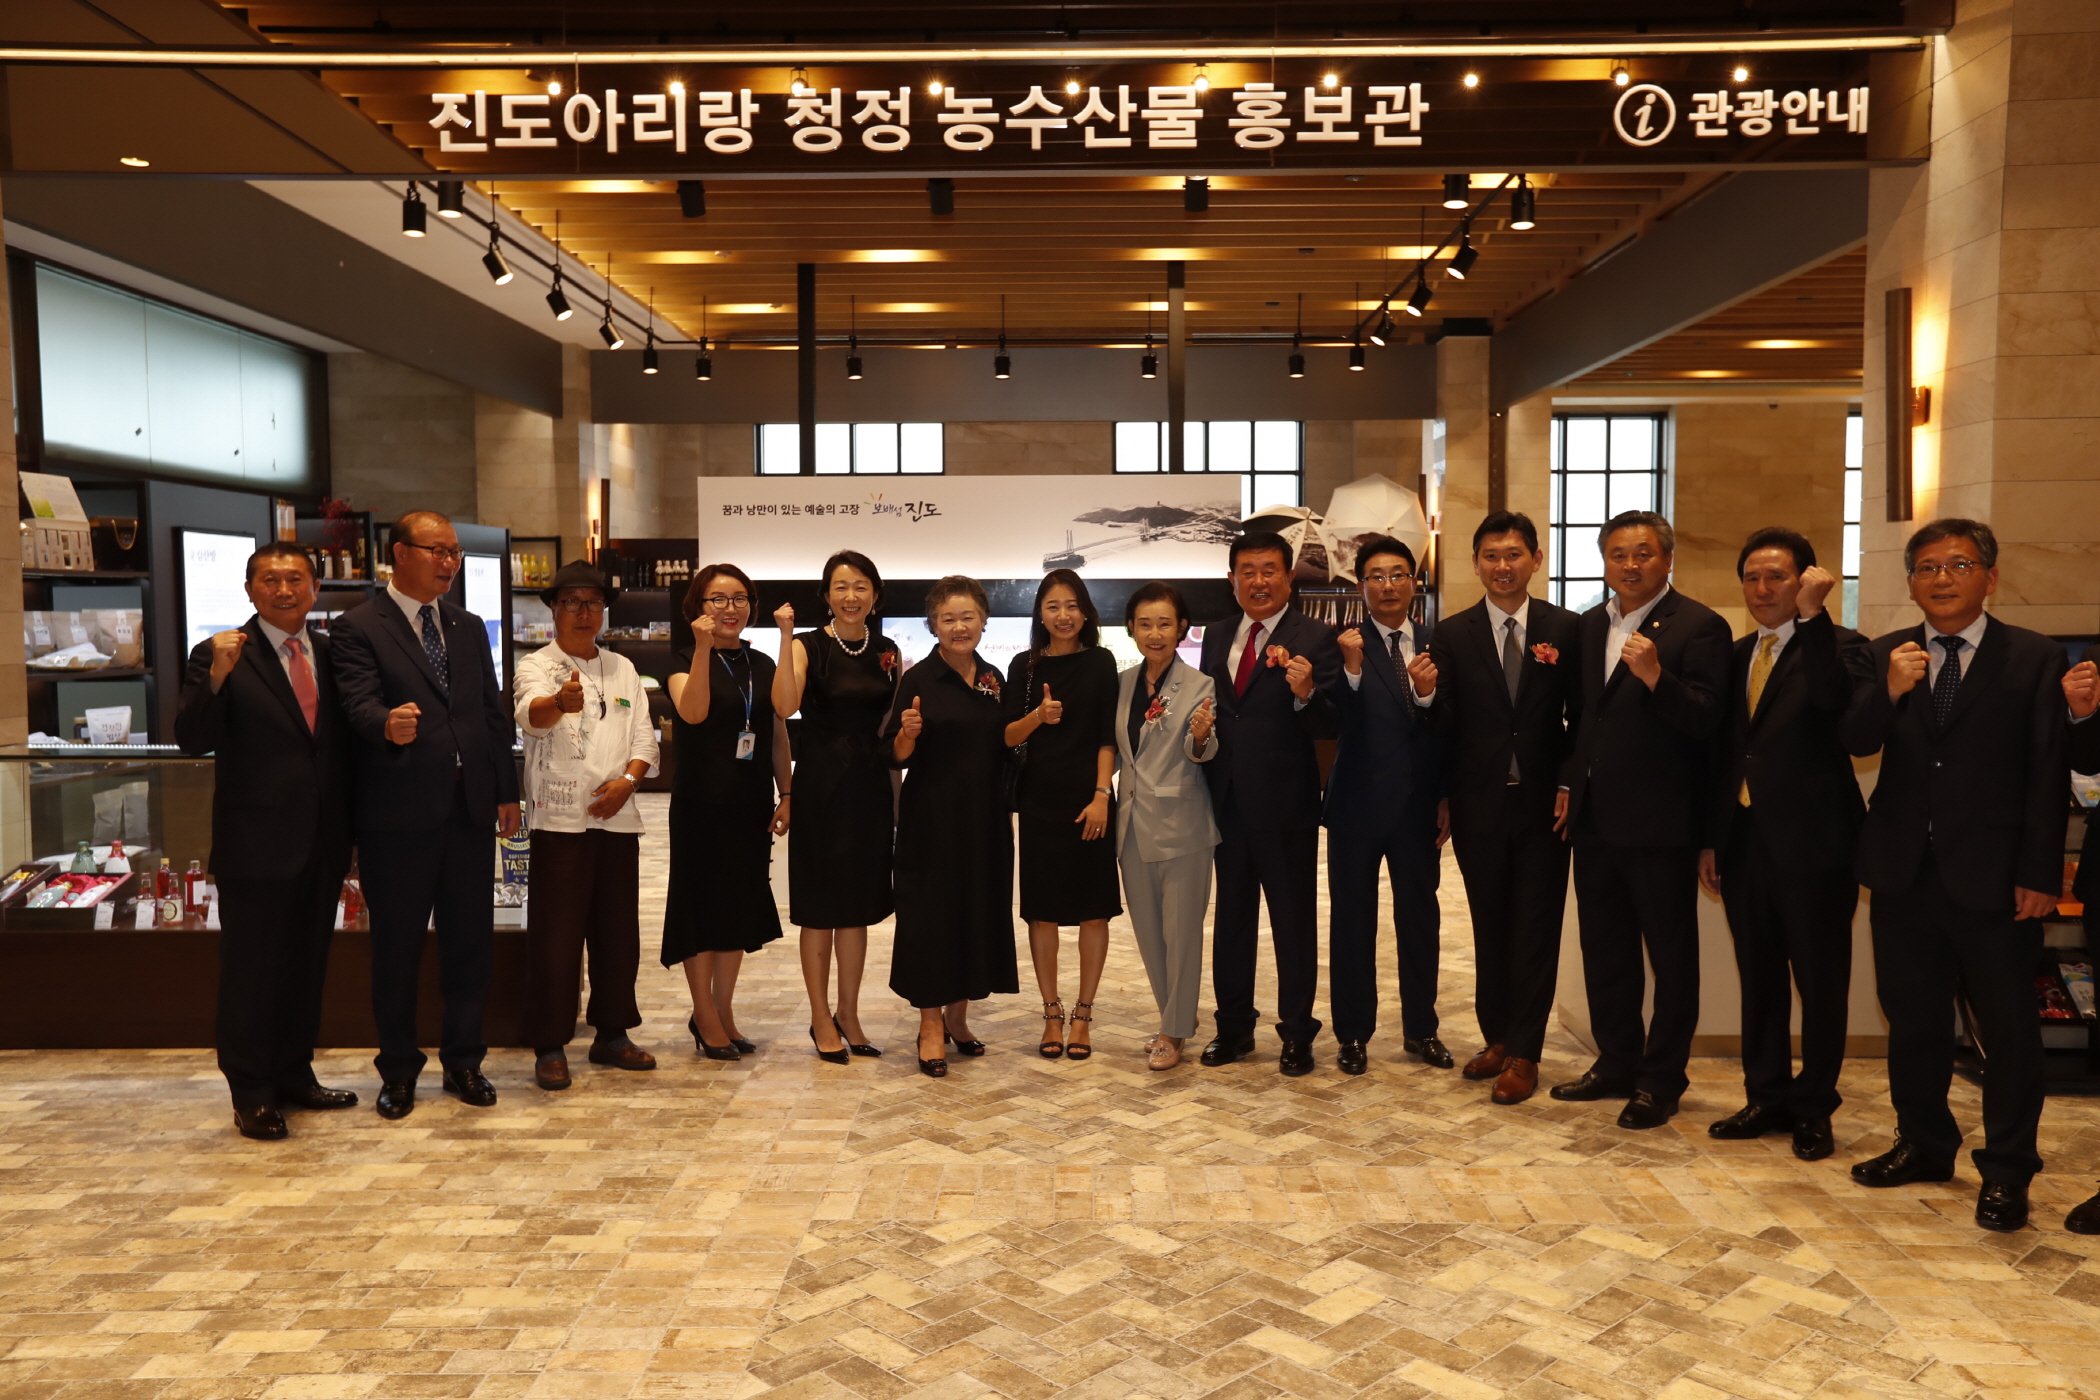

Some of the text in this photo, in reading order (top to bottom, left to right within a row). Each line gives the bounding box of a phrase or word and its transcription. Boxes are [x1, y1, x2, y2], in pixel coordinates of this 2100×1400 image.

[428, 82, 1430, 154] 진도아리랑 청정 농수산물 홍보관
[1688, 87, 1870, 137] 관광안내
[722, 504, 860, 516] 꿈과 낭만이 있는 예술의 고장
[872, 501, 942, 522] 보배섬 진도
[509, 830, 528, 839] 019
[504, 859, 530, 871] TAST
